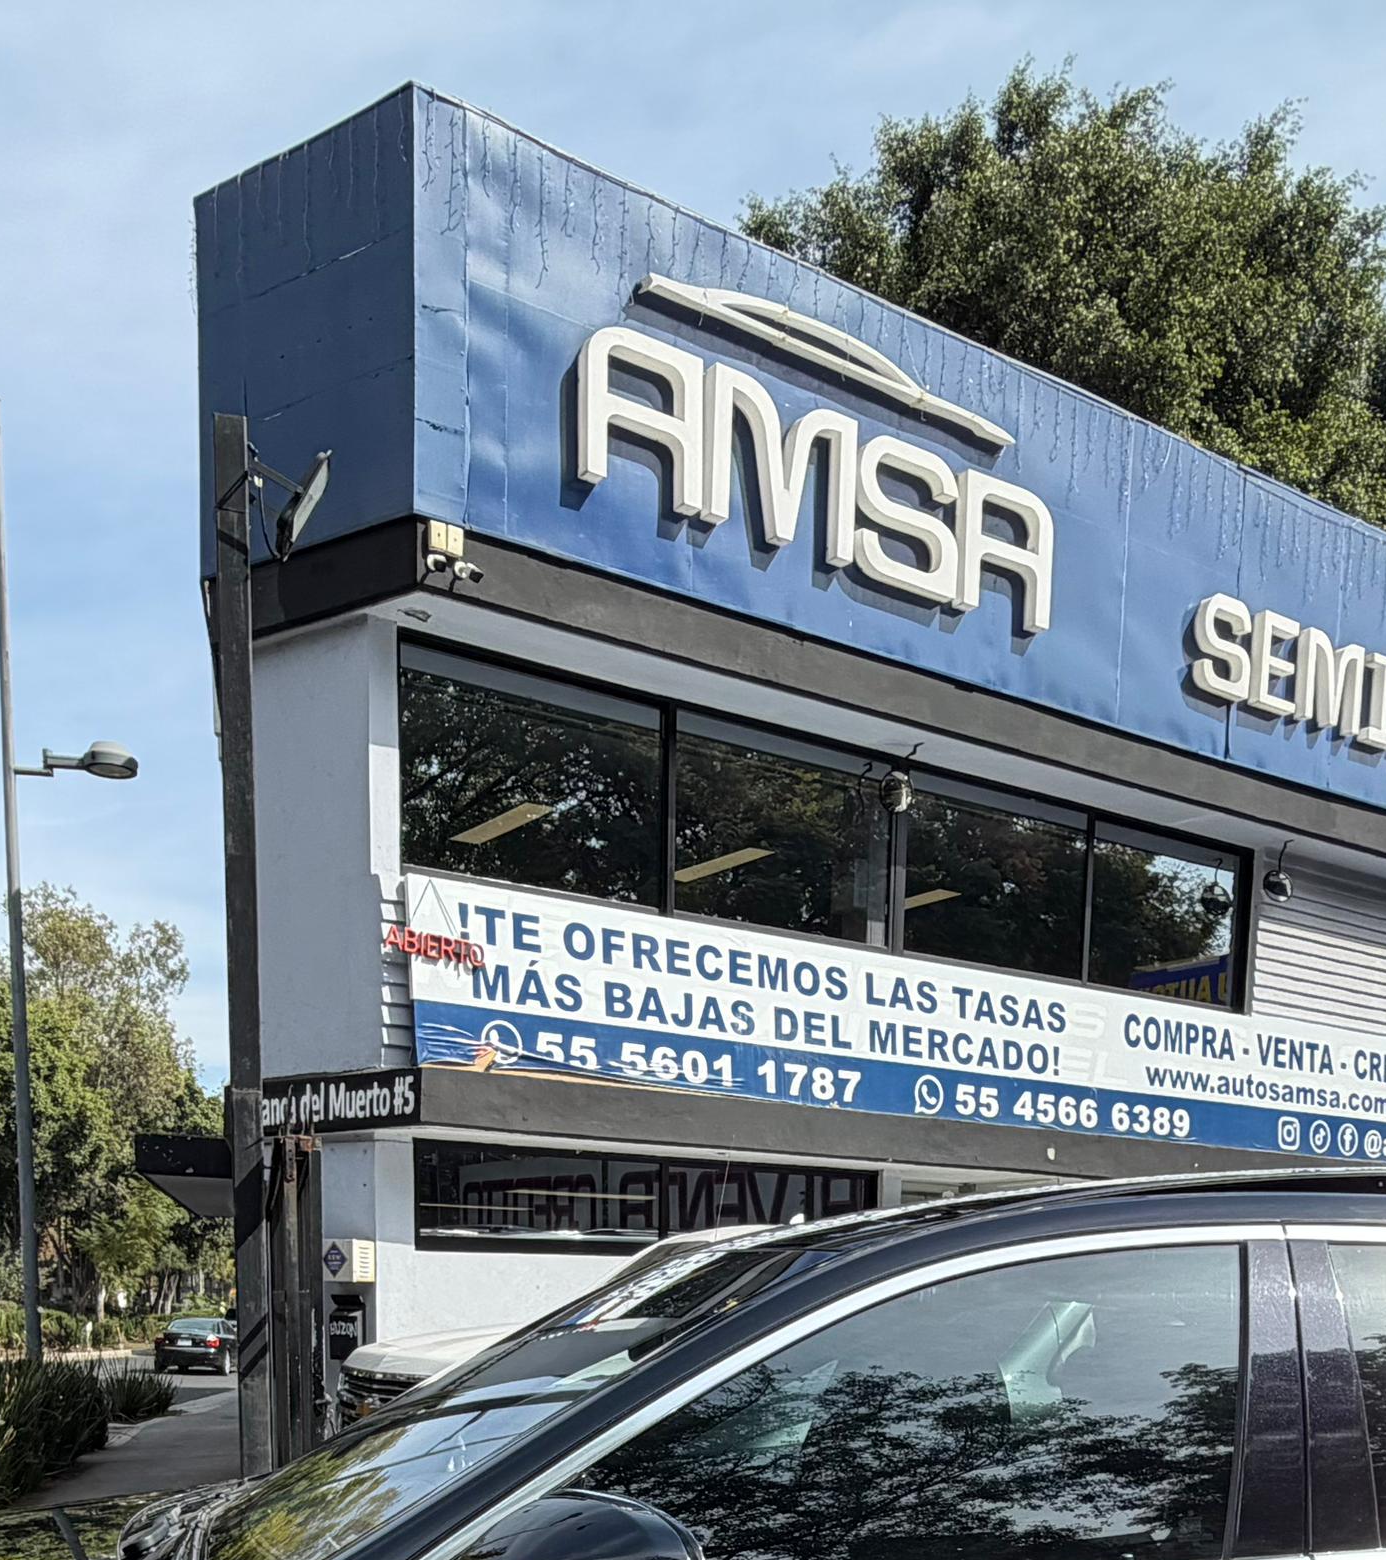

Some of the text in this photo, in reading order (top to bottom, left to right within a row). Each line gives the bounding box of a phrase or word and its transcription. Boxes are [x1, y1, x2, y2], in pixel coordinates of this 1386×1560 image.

[577, 326, 1055, 633] AMSA
[384, 924, 484, 967] ABIERTO
[563, 922, 848, 1001] OFRECEMOS
[865, 972, 938, 1014] LAS
[952, 986, 1066, 1033] TASAS
[472, 960, 583, 1012] MÁS
[604, 981, 755, 1036] BAJAS
[774, 1006, 852, 1050] DEL
[869, 1020, 1060, 1076] MERCADO!
[1123, 1013, 1235, 1061] COMPRA
[1257, 1034, 1334, 1075] VENTA
[300, 1082, 325, 1124] del
[329, 1081, 391, 1121] Muerto
[393, 1075, 414, 1116] #5
[536, 1031, 861, 1103] 55 5601 1787
[955, 1083, 1190, 1138] 55 4566 6389
